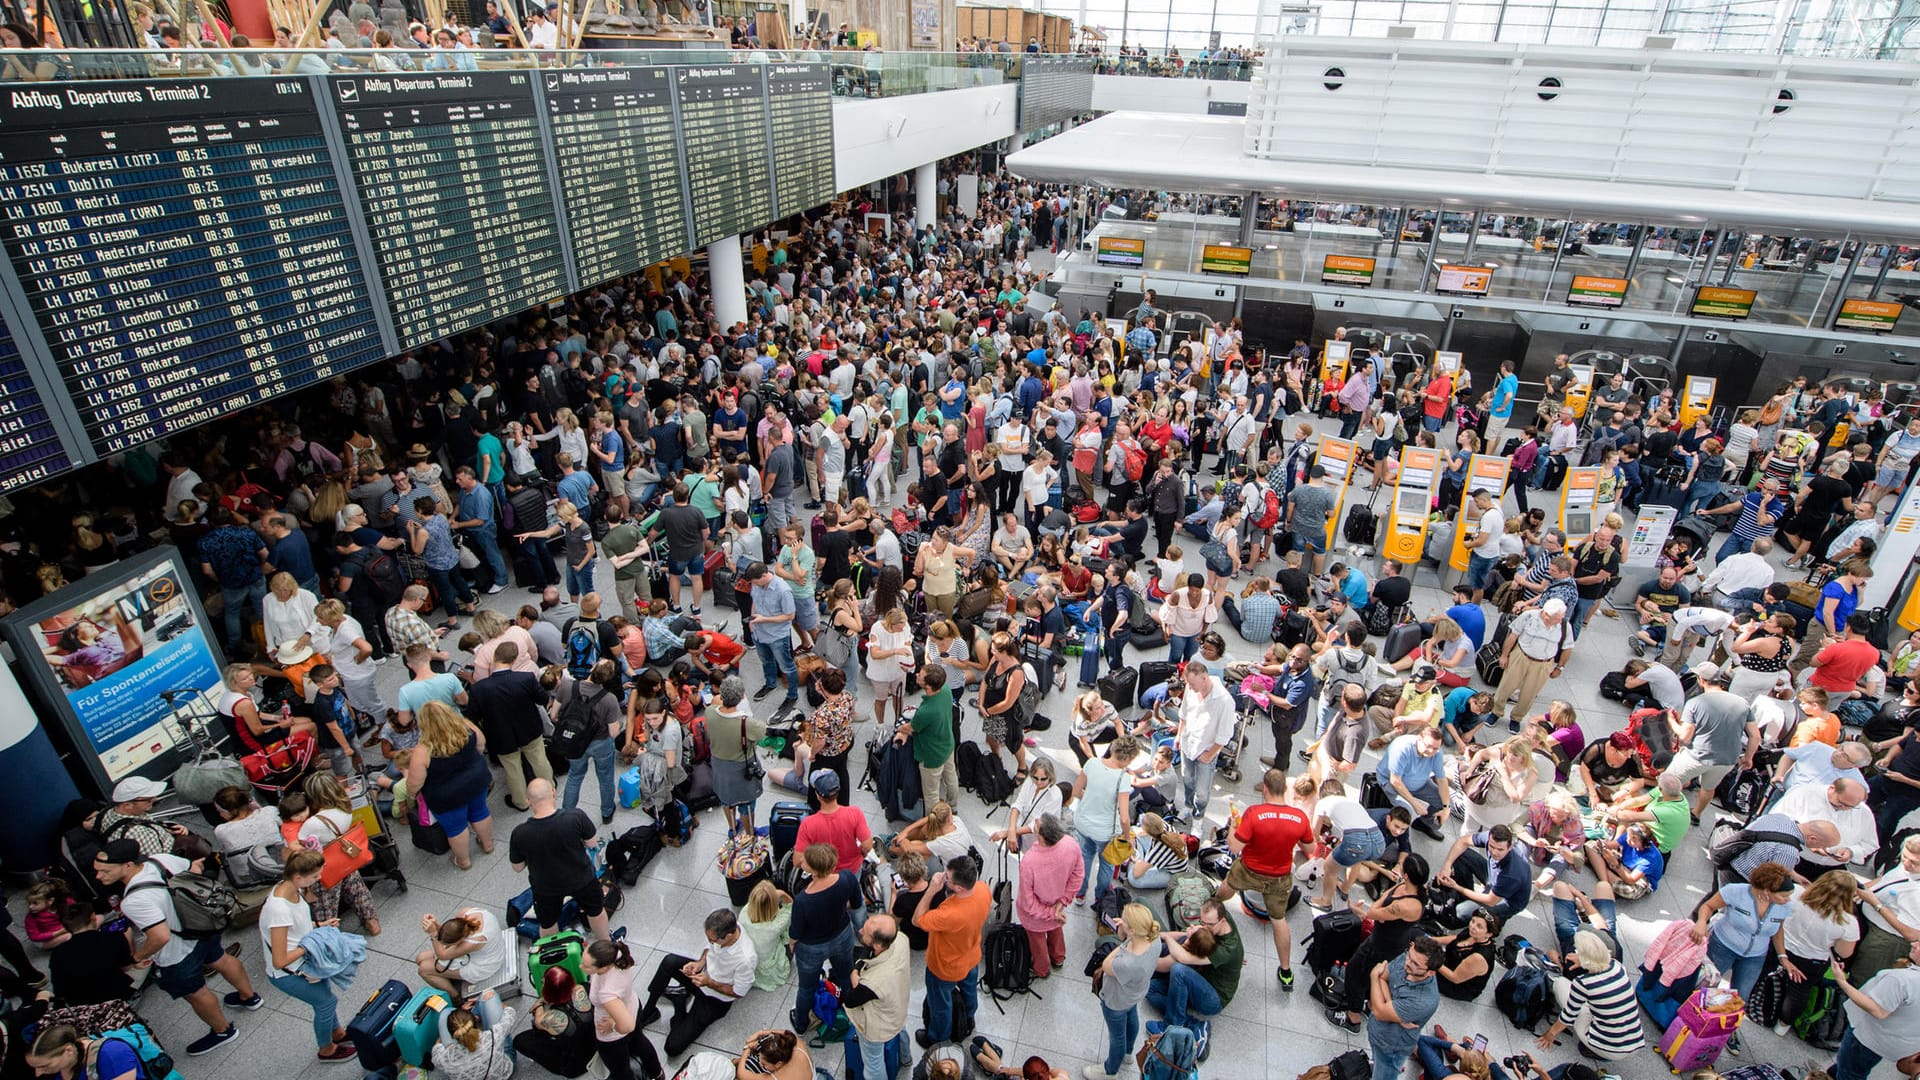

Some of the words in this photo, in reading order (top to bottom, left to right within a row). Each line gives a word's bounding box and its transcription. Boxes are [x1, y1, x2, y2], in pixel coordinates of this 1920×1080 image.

[12, 91, 62, 109] Abflug
[66, 88, 142, 107] Departures
[146, 85, 200, 102] Terminal
[200, 85, 211, 99] 2
[364, 79, 391, 93] Abflug
[394, 78, 435, 92] Departures
[436, 76, 466, 88] Terminal
[466, 76, 473, 87] 2
[0, 168, 9, 180] H
[16, 164, 48, 178] 1652
[61, 159, 119, 174] Bukarest
[177, 150, 208, 162] 08:25
[245, 144, 263, 155] H41
[0, 187, 17, 199] LH
[22, 183, 56, 197] 2514
[68, 178, 113, 192] Dublin
[182, 166, 214, 178] 08:25
[250, 159, 268, 170] H40
[6, 206, 24, 218] LH
[31, 201, 63, 215] 1800
[75, 194, 120, 209] Madrid
[188, 181, 219, 194] 08:25
[255, 174, 273, 185] K25
[14, 224, 32, 236] EN
[37, 219, 70, 233] 8208
[82, 213, 126, 226] Verona
[193, 197, 224, 210] 08:25
[29, 260, 47, 272] LH
[52, 254, 84, 268] 2654
[96, 235, 193, 260] Madeira/Funchal
[204, 227, 234, 242] 08:30
[37, 278, 55, 290] LH
[60, 271, 91, 285] 2500
[103, 258, 168, 277] Manchester
[209, 242, 239, 257] 08:30
[273, 232, 291, 244] H29
[52, 312, 69, 324] LH
[74, 304, 104, 319] 2462
[116, 290, 168, 310] Helsinki
[220, 272, 249, 287] 08:40
[1586, 281, 1616, 289] Lufthansa
[1713, 292, 1743, 300] Lufthansa
[59, 329, 77, 341] LH
[81, 320, 111, 336] 2472
[122, 310, 163, 326] London
[225, 286, 254, 301] 08:40
[287, 274, 304, 286] H19
[1858, 304, 1889, 313] Lufthansa
[73, 361, 90, 374] LH
[95, 352, 124, 368] 2302
[135, 336, 192, 357] Amsterdam
[235, 315, 263, 330] 08:45
[81, 377, 97, 390] LH
[103, 368, 131, 384] 1784
[141, 356, 180, 373] Ankara
[240, 329, 268, 344] 08:50
[272, 320, 297, 335] 10:15
[300, 315, 316, 327] L19
[319, 305, 355, 321] Check-in
[87, 393, 104, 406] LH
[108, 383, 137, 400] 2428
[147, 367, 198, 388] Göteborg
[245, 343, 273, 358] 08:50
[304, 328, 320, 340] K10
[94, 408, 111, 422] LH
[116, 398, 143, 415] 1962
[153, 372, 231, 403] Lamezia-Terme
[250, 356, 277, 372] 08:55
[101, 424, 117, 437] LH
[121, 413, 149, 430] 2550
[159, 397, 202, 417] Lemberg
[255, 370, 282, 385] 08:55
[312, 354, 328, 366] H26
[108, 439, 124, 452] LH
[128, 428, 156, 445] 2414
[165, 407, 219, 431] Stockholm
[259, 383, 286, 399] 08:55
[317, 367, 332, 379] K09
[0, 464, 48, 490] spätet
[76, 693, 100, 710] Für
[101, 641, 193, 698] Spontanreisende
[562, 729, 575, 739] CAT
